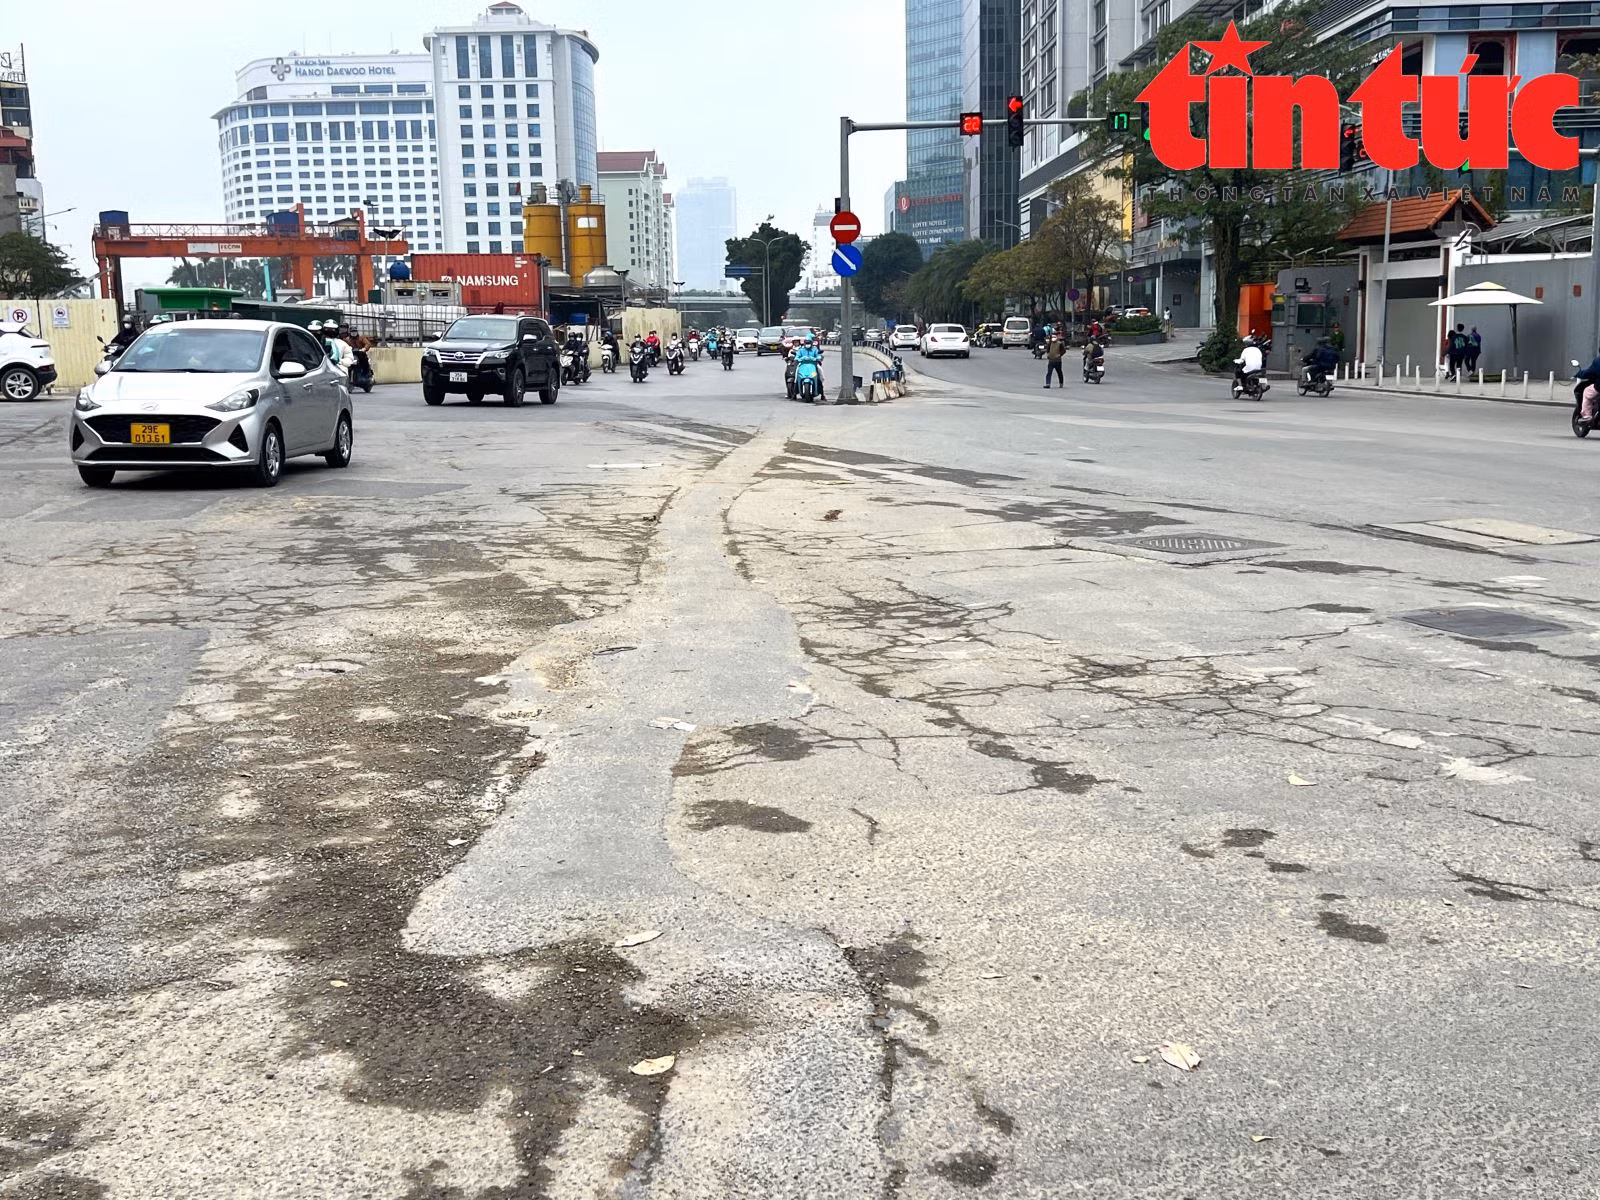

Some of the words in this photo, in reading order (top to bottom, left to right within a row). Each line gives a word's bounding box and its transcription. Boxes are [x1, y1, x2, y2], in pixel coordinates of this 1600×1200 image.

[295, 66, 324, 76] HANOI
[327, 66, 366, 76] DAEWOO
[368, 65, 395, 75] HOTEL
[963, 116, 980, 132] 22
[457, 275, 519, 287] NAMSUNG
[142, 425, 158, 434] 29E
